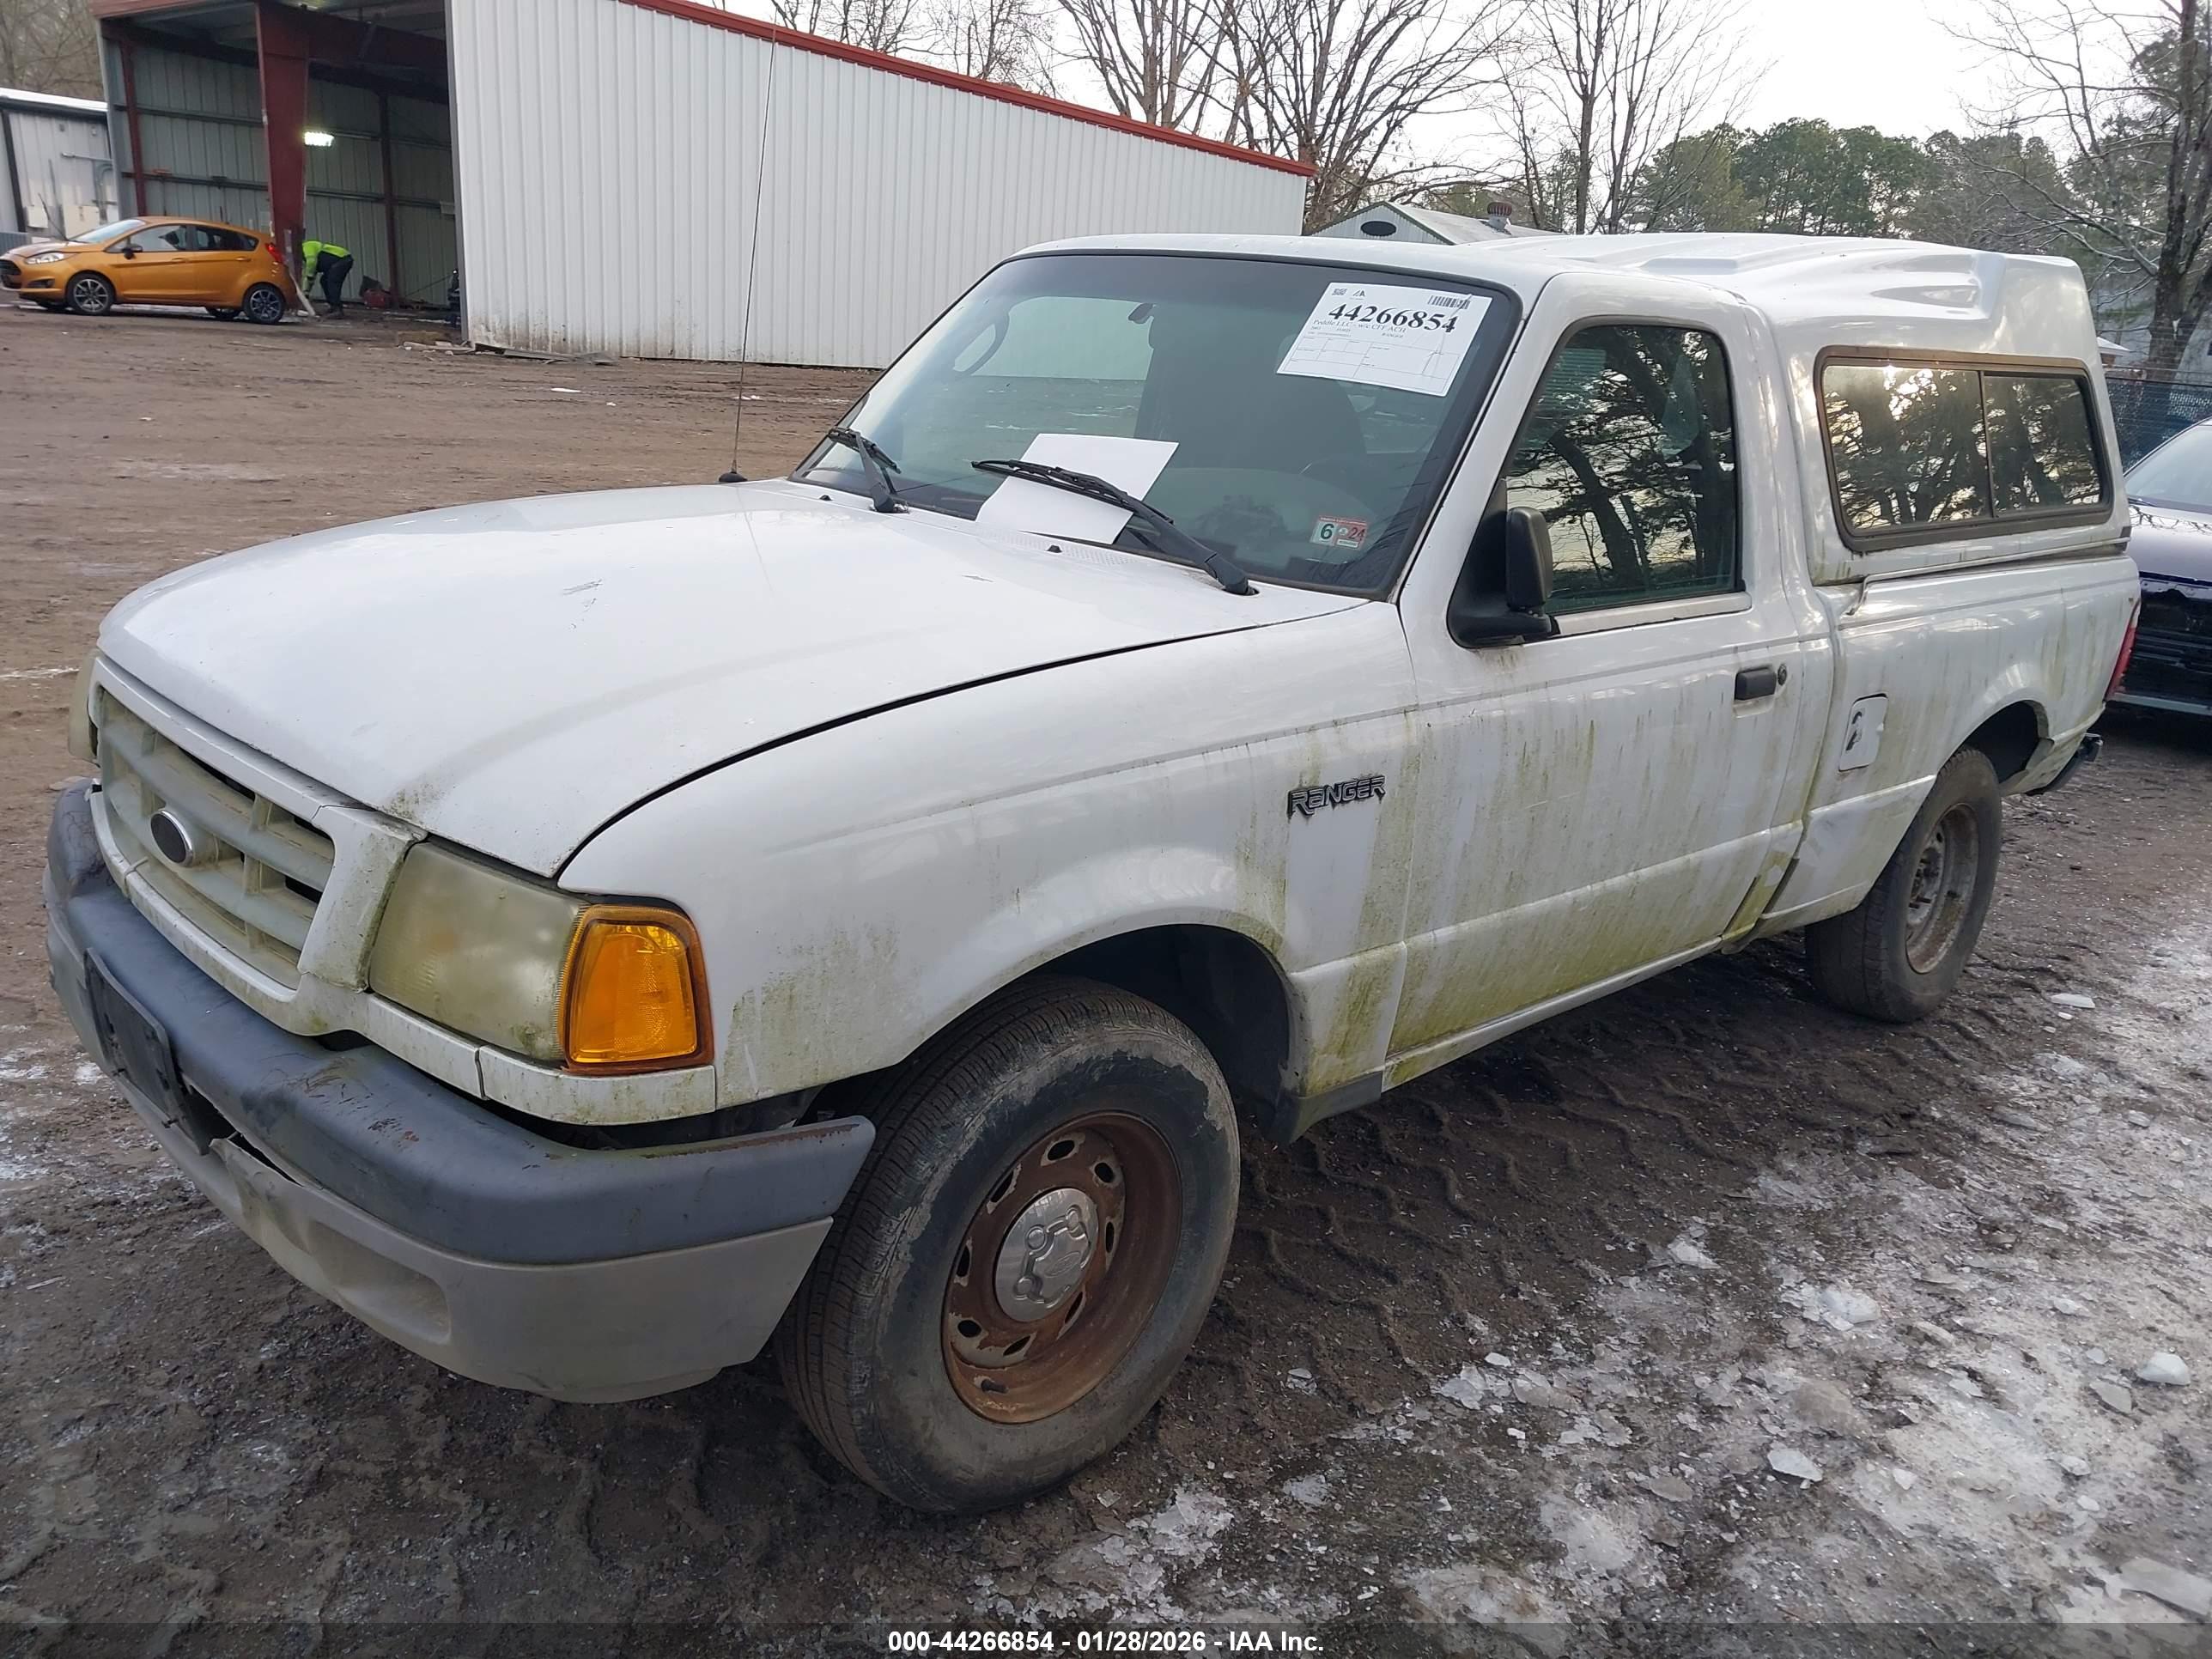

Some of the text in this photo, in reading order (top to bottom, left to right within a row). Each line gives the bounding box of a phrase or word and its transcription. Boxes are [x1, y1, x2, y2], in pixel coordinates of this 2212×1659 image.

[1328, 303, 1457, 333] 44266854
[1321, 523, 1334, 539] 6
[1287, 775, 1386, 817] RANGER
